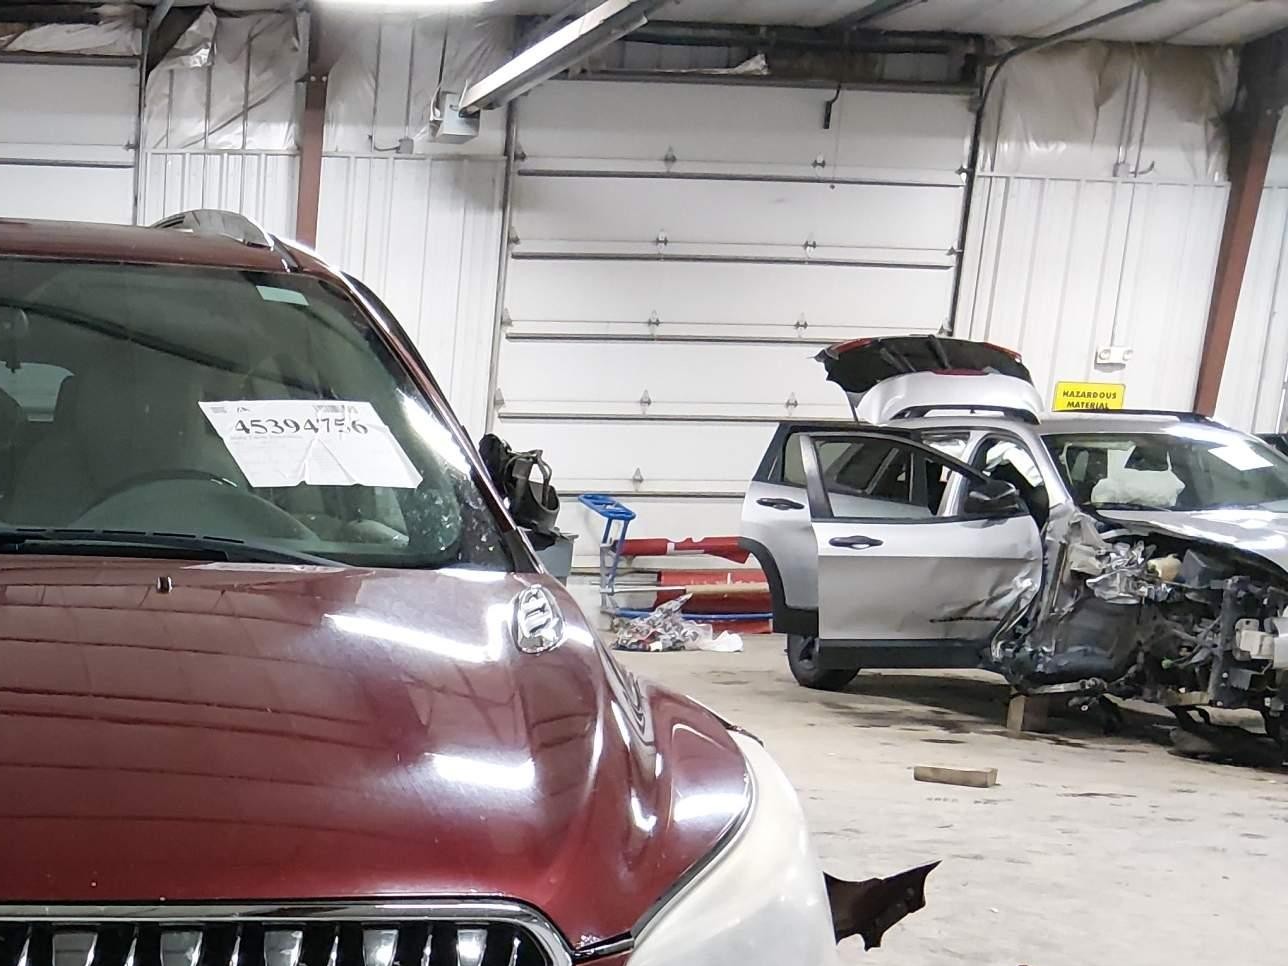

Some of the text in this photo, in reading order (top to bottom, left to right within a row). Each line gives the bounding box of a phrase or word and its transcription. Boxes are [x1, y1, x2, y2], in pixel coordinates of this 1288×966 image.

[1063, 390, 1117, 400] HAZARDOUS
[1066, 401, 1110, 410] MATERIAL
[234, 417, 369, 435] 45394756
